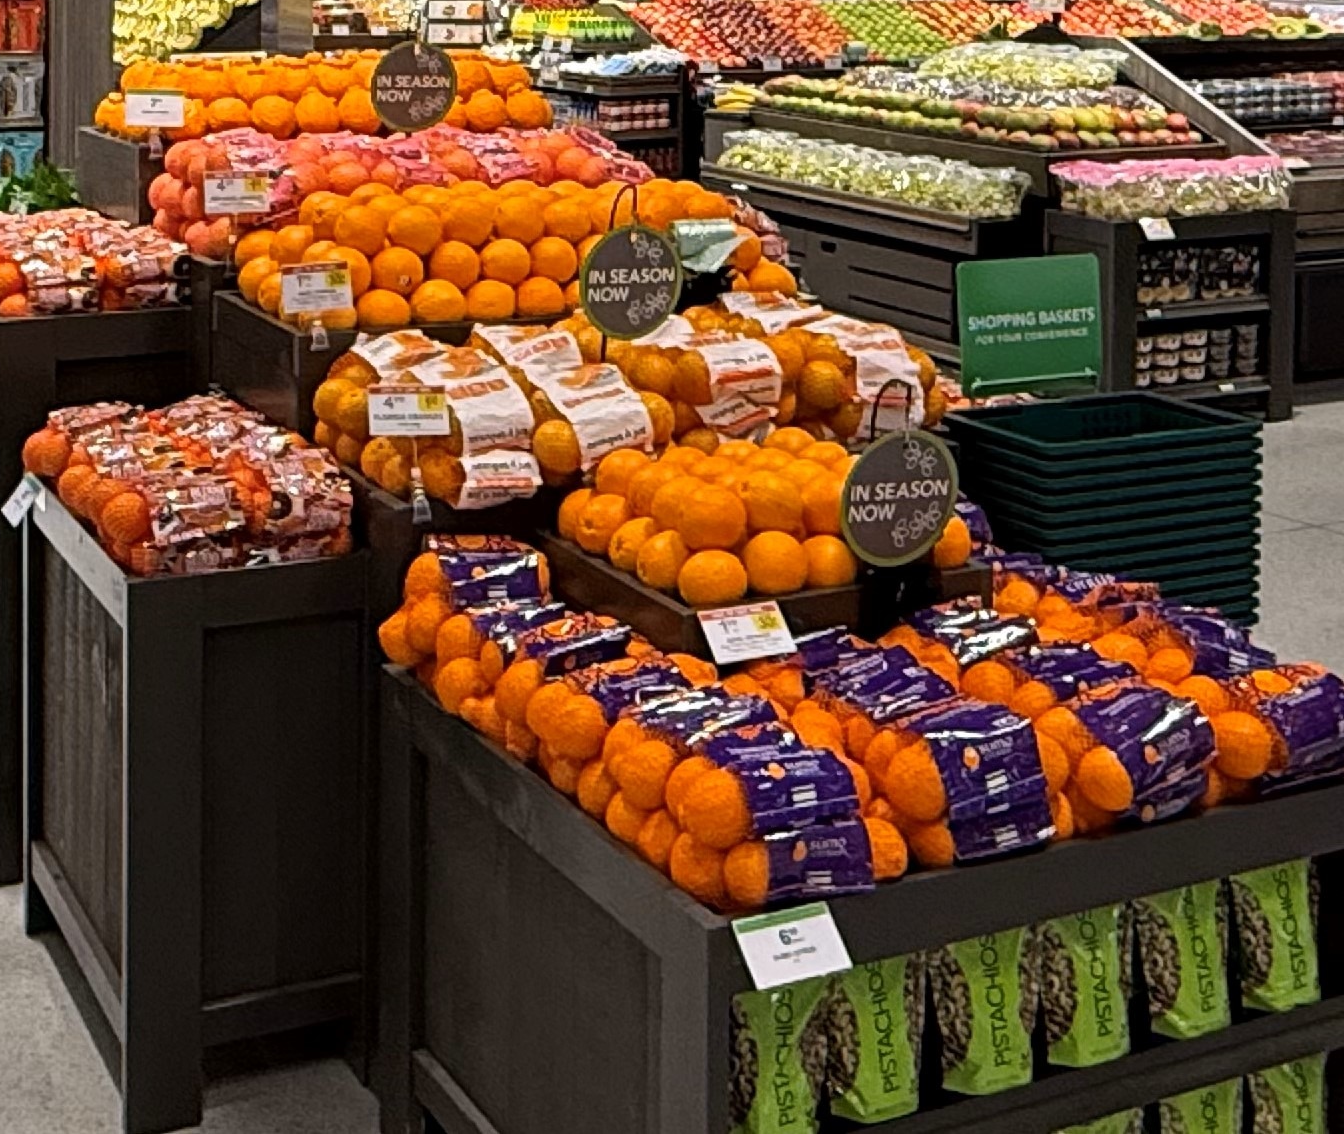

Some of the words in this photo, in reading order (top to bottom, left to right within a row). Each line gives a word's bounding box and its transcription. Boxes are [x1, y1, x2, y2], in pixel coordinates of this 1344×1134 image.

[376, 75, 392, 88] IN
[395, 74, 450, 88] SEASON
[376, 89, 412, 102] NOW
[588, 270, 606, 284] IN
[610, 266, 675, 284] SEASON
[588, 286, 630, 303] NOW
[968, 311, 1036, 331] SHOPPING
[1038, 306, 1096, 325] BASKETS
[850, 484, 871, 502] IN
[874, 479, 949, 501] SEASON
[848, 503, 896, 524] NOW
[1272, 868, 1307, 991] PISTACHIOS
[978, 934, 1012, 1068] PISTACHIOS
